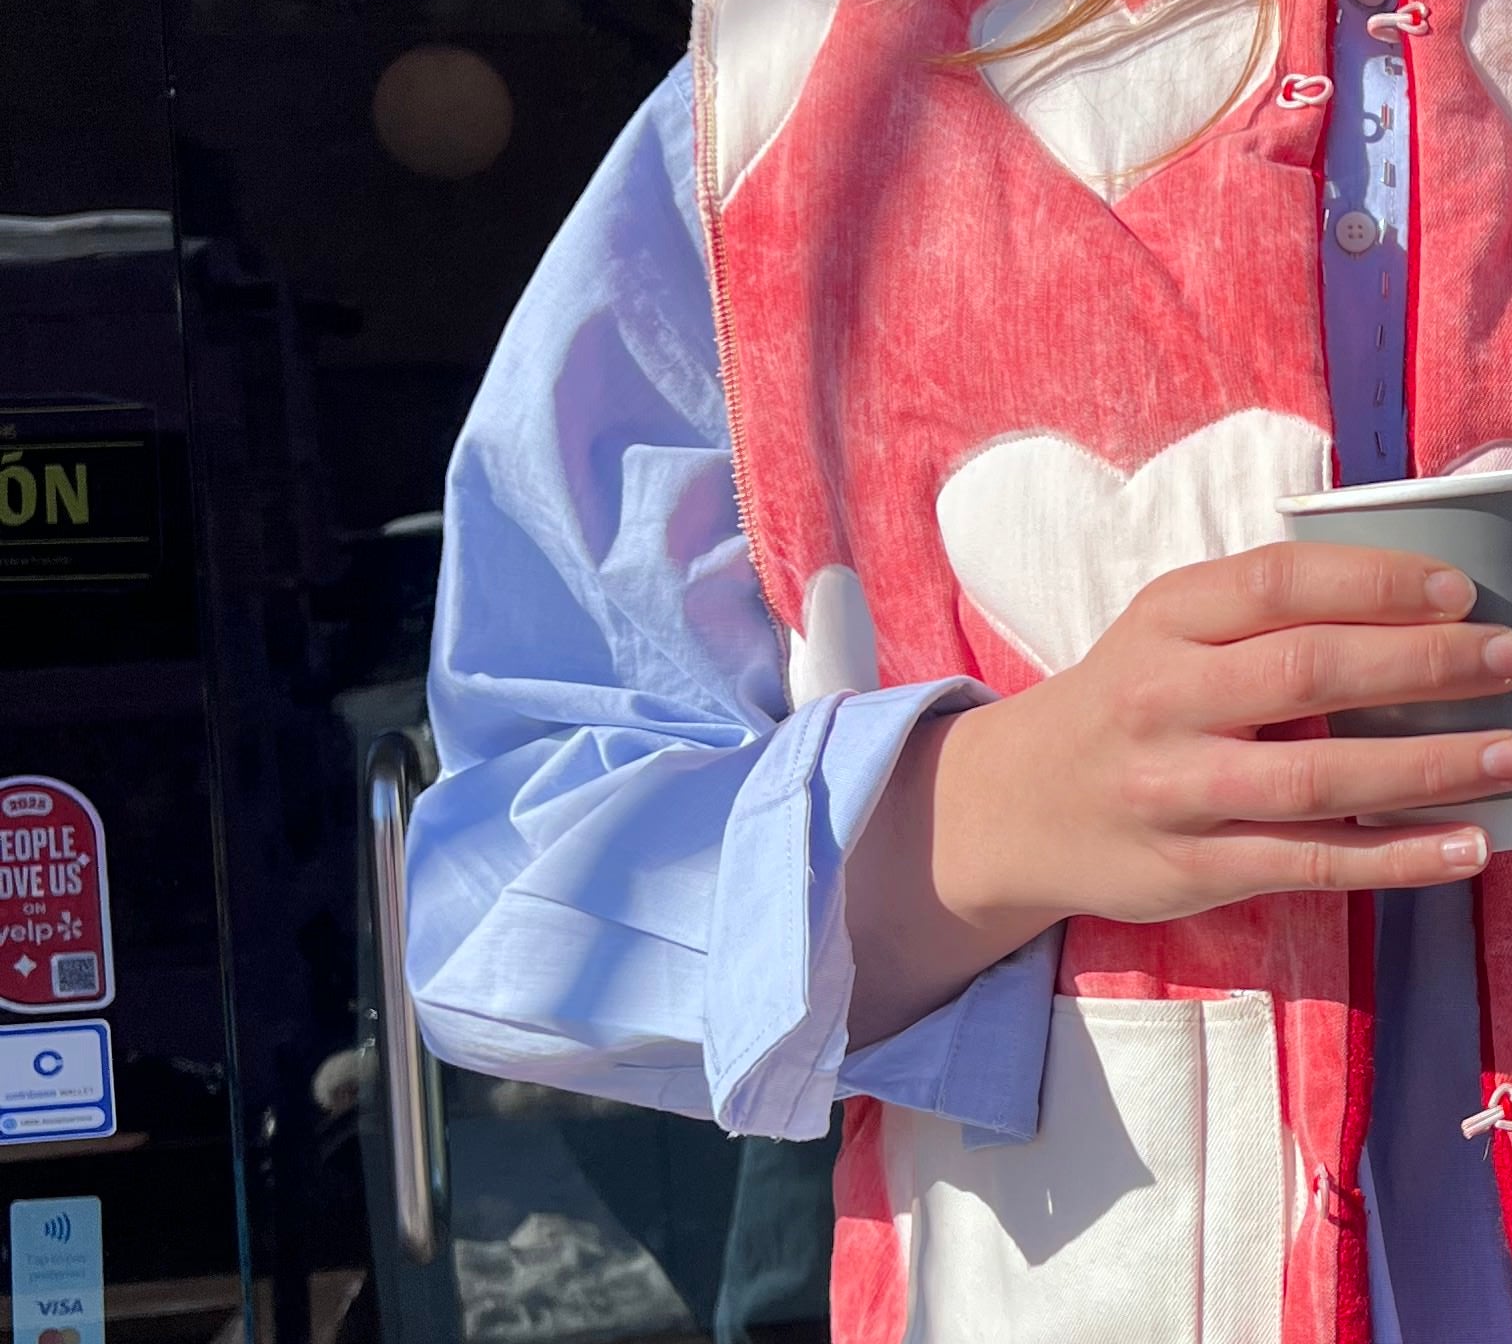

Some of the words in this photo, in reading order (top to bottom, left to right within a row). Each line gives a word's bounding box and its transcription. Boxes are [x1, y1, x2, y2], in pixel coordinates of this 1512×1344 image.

[0, 824, 77, 863] EOPLE
[49, 861, 82, 896] US
[23, 902, 46, 915] ON
[0, 918, 53, 946] yelp
[36, 1298, 84, 1316] VISA
